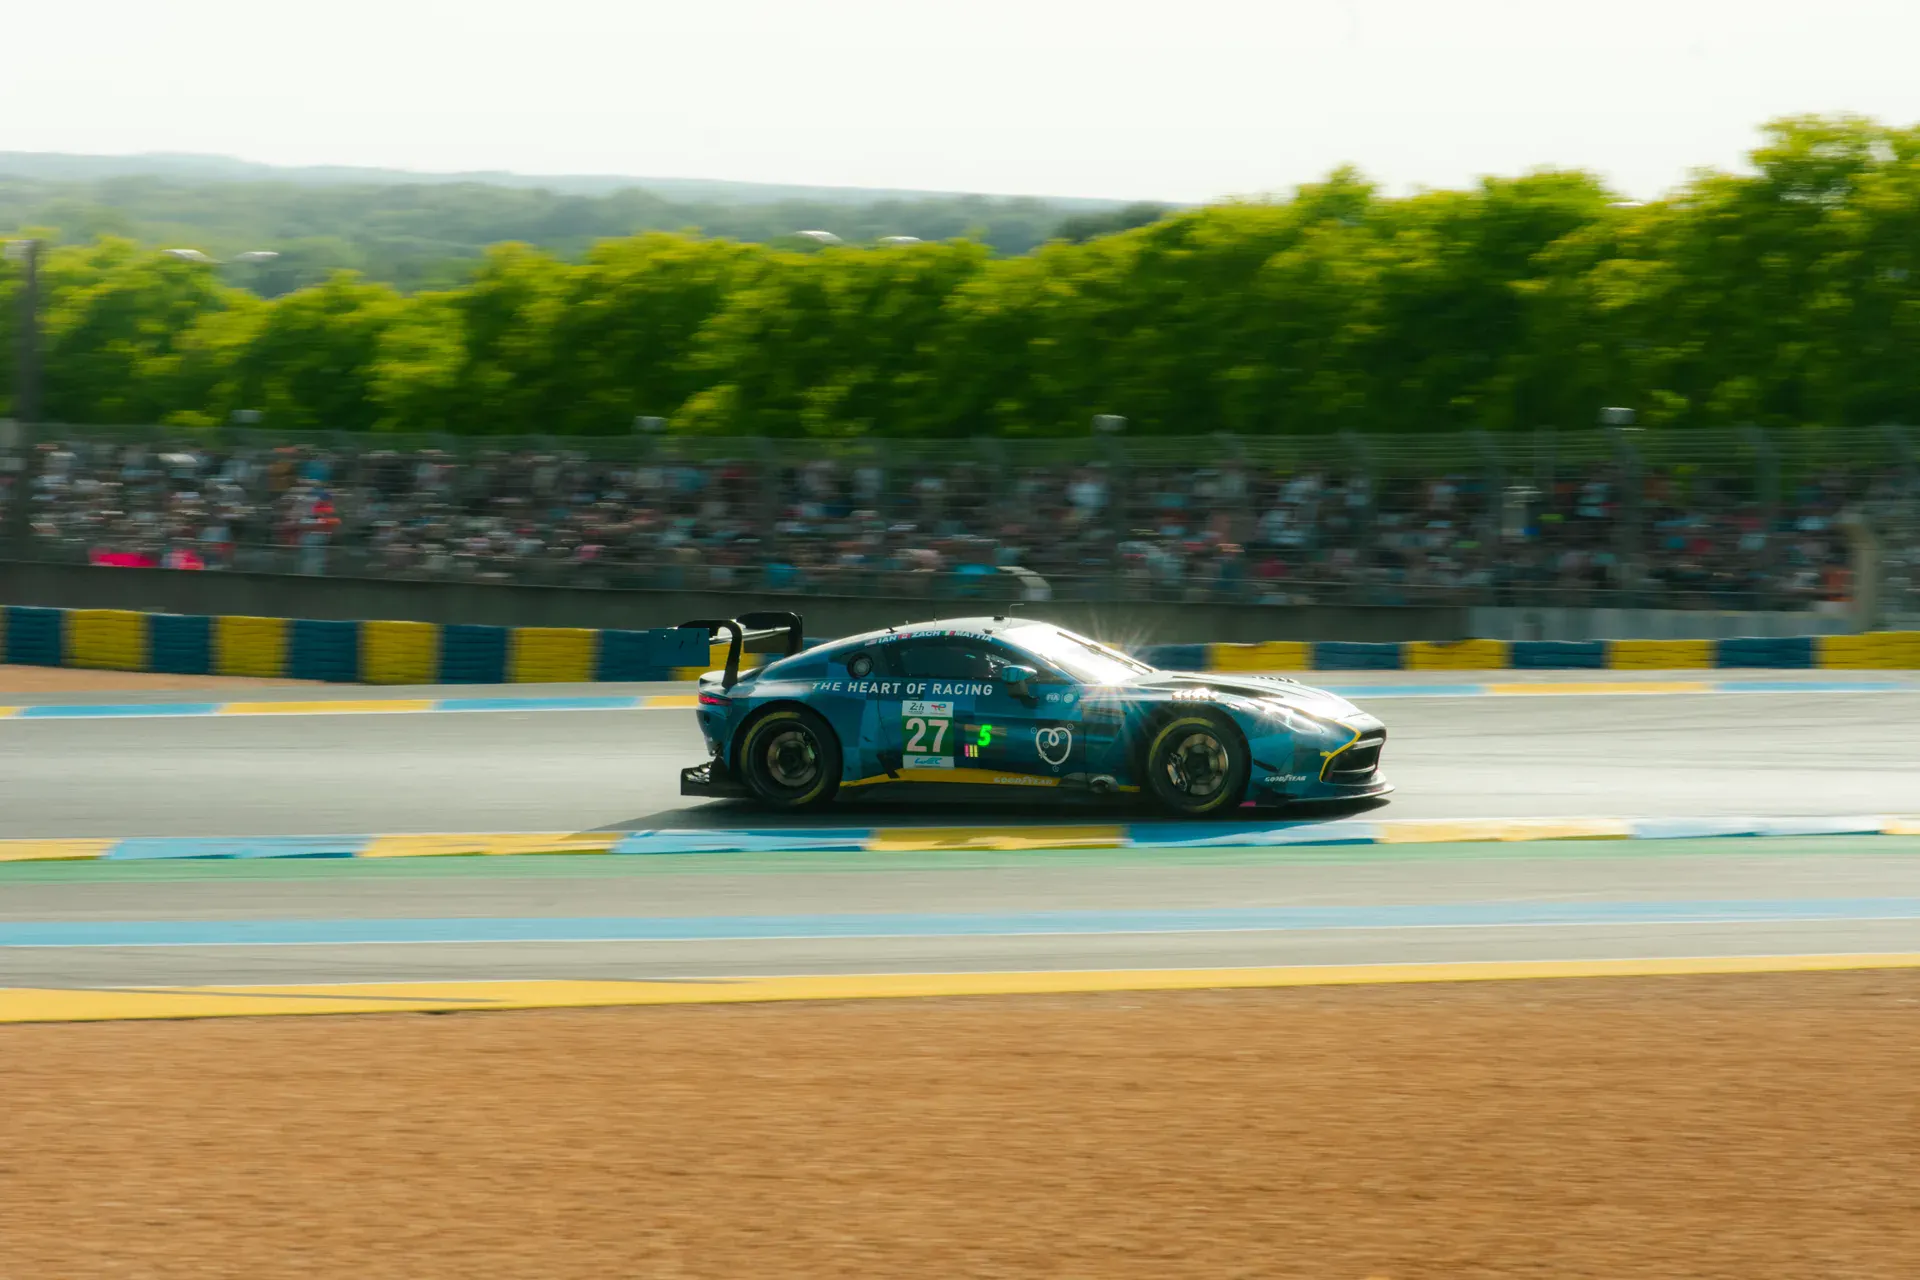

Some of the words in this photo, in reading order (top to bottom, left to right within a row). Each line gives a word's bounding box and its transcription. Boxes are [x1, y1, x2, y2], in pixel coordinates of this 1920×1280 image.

[878, 635, 898, 644] IAN
[911, 630, 940, 638] ZACH
[954, 630, 993, 642] MATTIA
[812, 682, 842, 692] THE
[847, 682, 902, 695] HEART
[906, 683, 927, 695] OF
[933, 683, 993, 696] RACING
[905, 717, 949, 753] 27
[977, 724, 992, 747] 5
[993, 776, 1053, 786] GOODYEAR
[1264, 774, 1307, 782] GOODYEAR
